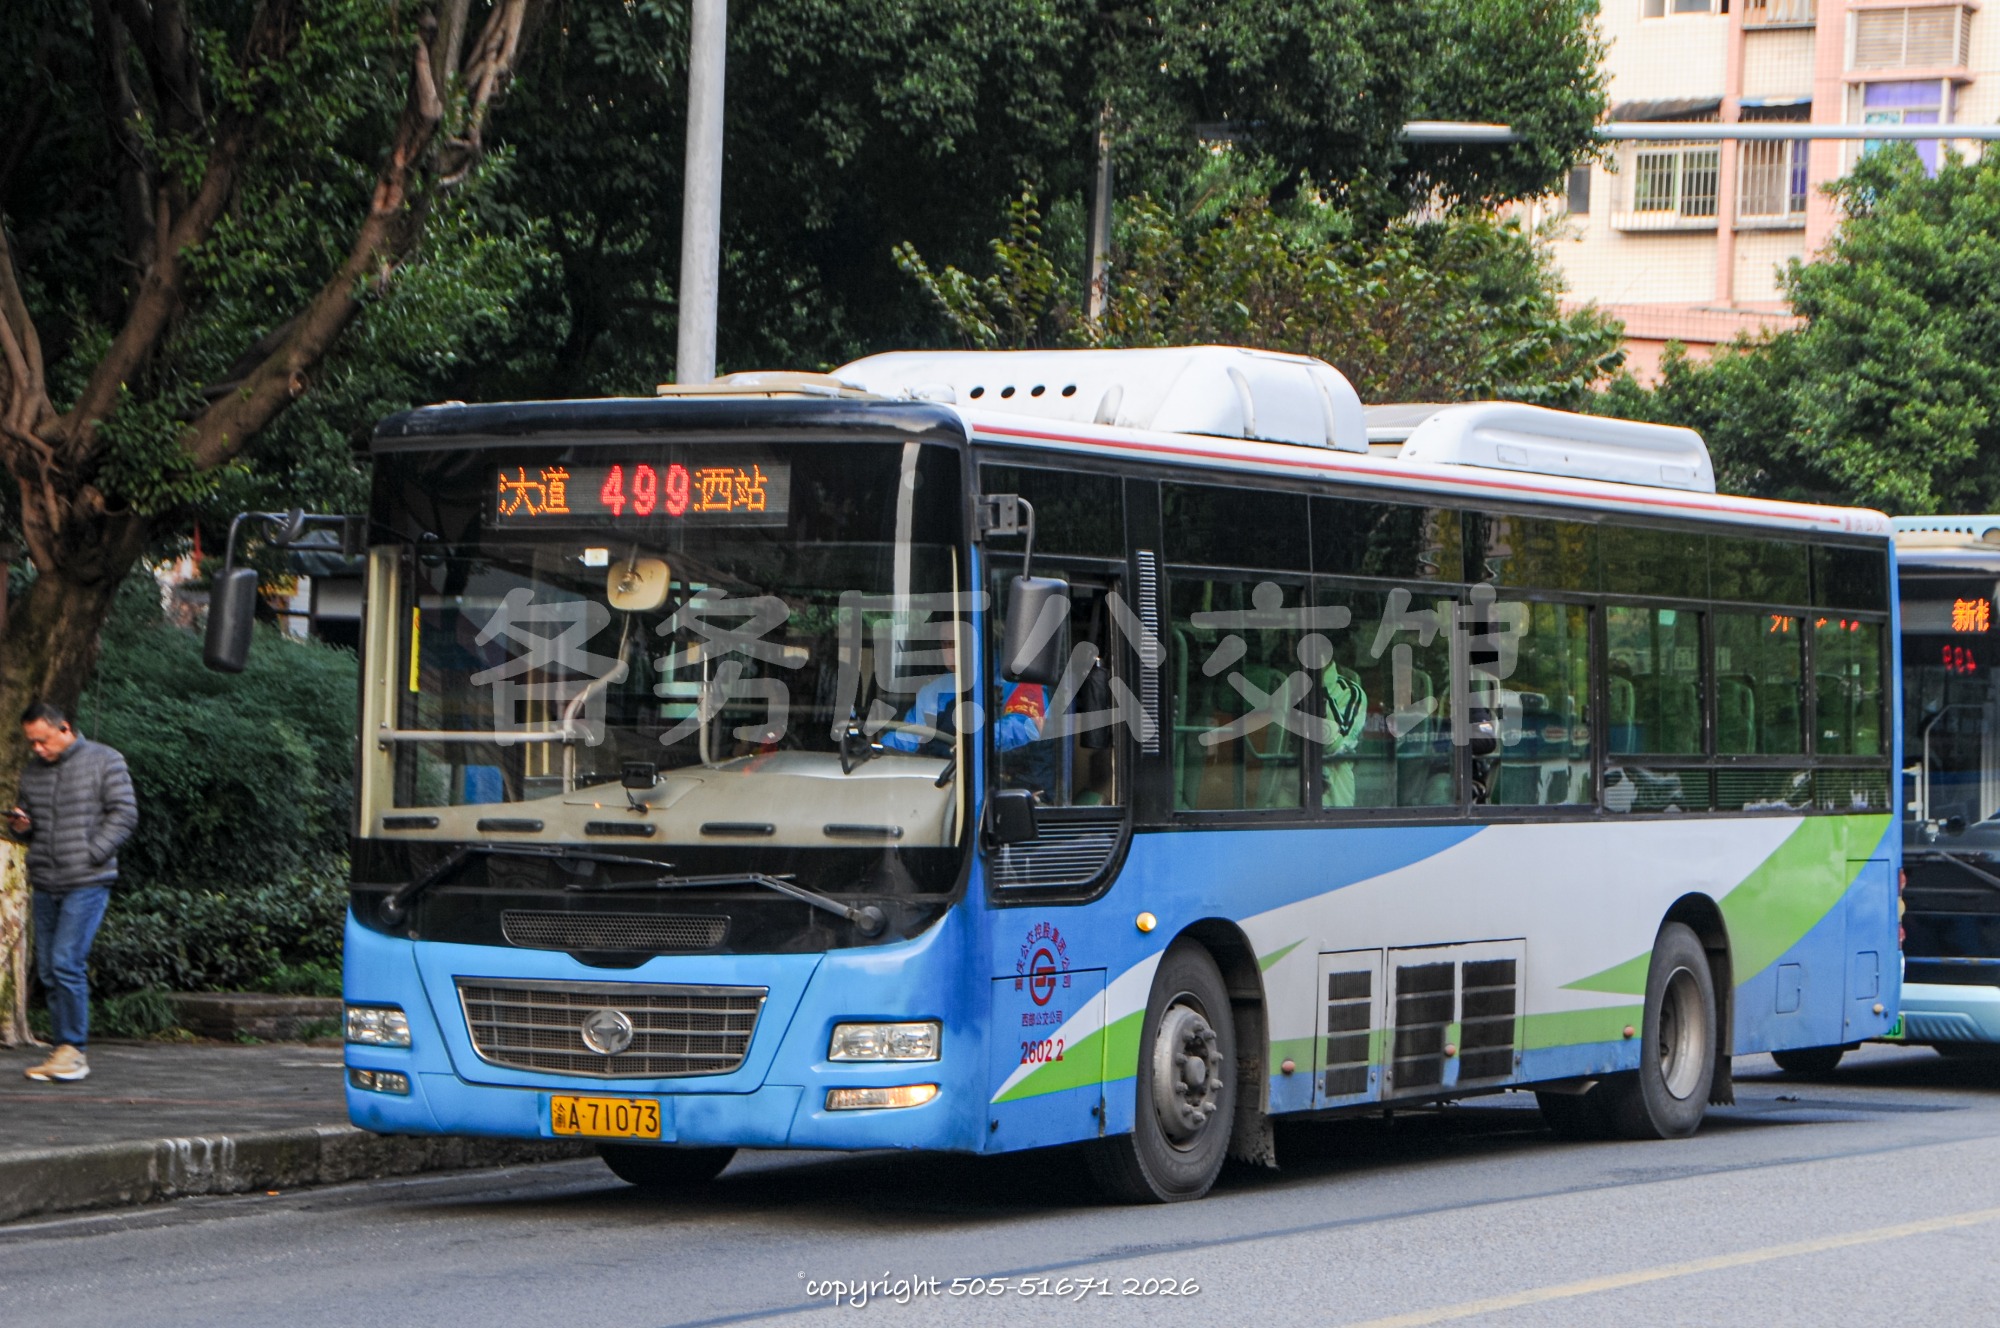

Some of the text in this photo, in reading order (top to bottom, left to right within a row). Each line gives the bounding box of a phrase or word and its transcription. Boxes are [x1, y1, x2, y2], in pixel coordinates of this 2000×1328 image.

[499, 464, 769, 517] 大道 499 西站
